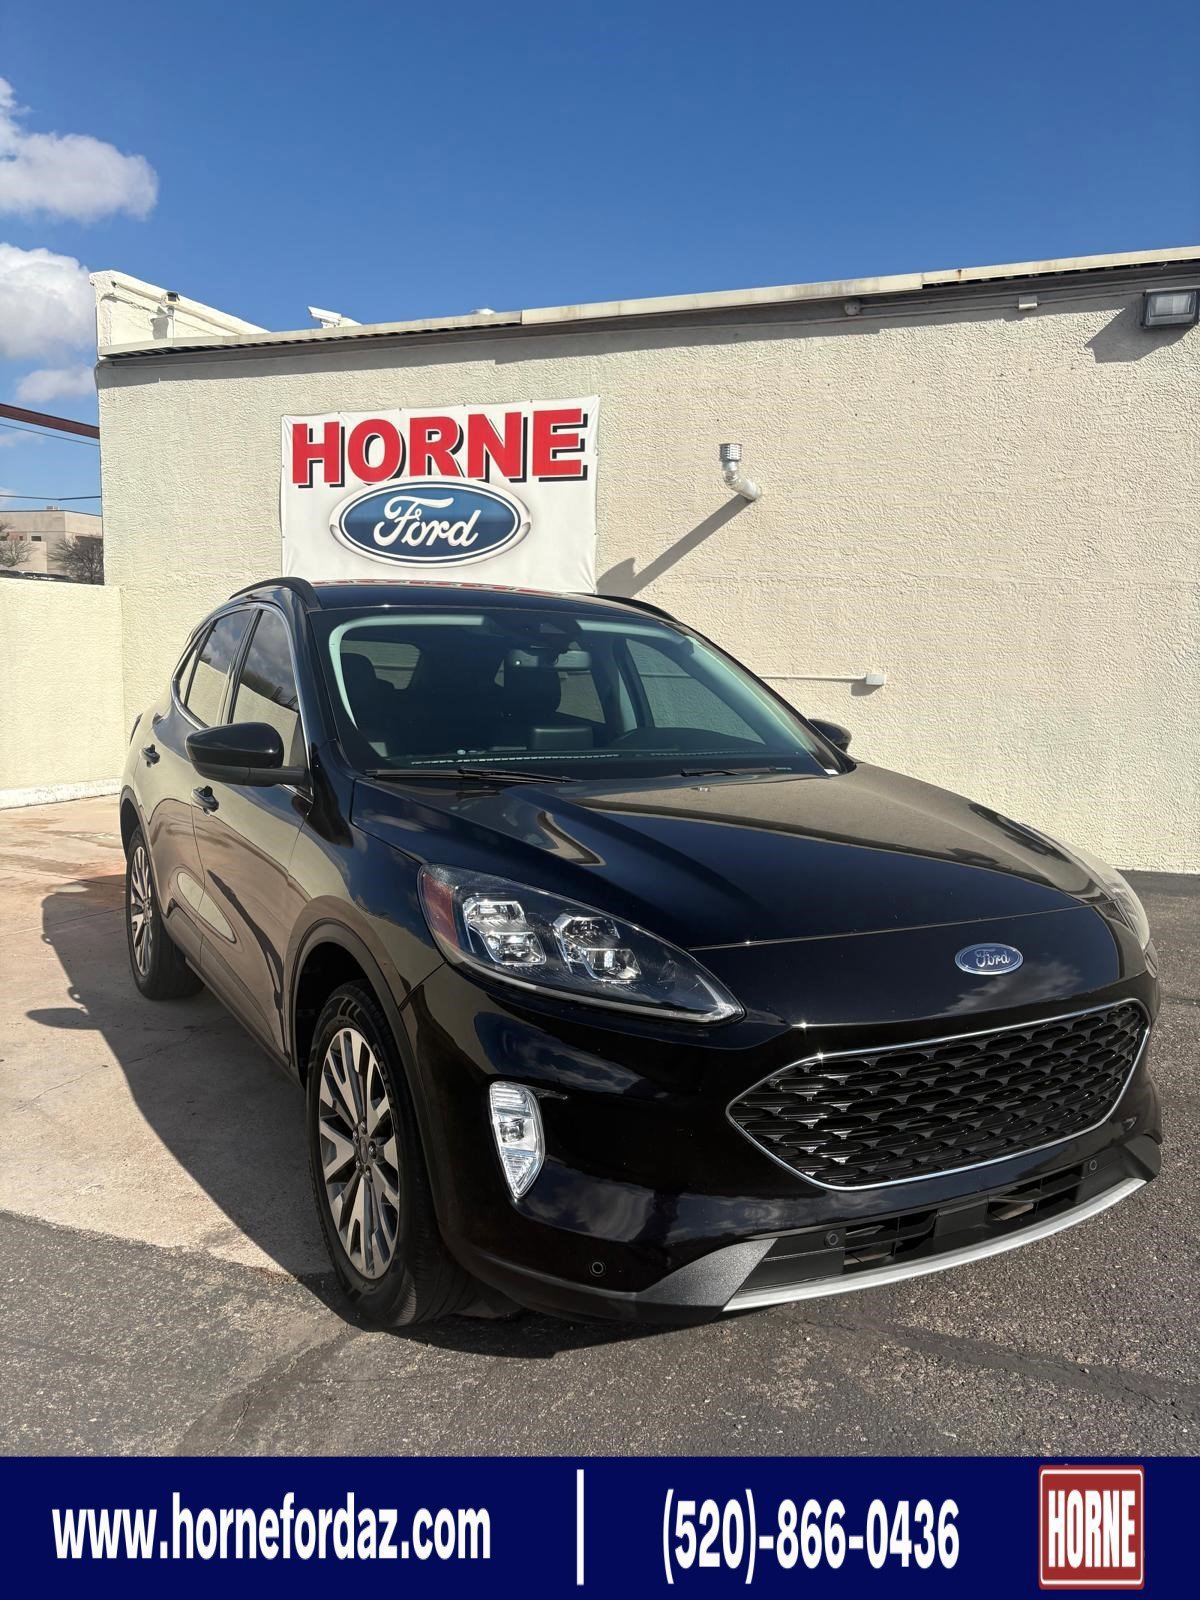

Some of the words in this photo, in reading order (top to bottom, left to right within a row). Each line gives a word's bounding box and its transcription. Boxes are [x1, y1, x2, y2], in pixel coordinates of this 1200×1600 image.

[292, 408, 589, 488] HORNE
[373, 495, 482, 547] Ford
[974, 947, 1011, 968] Ford
